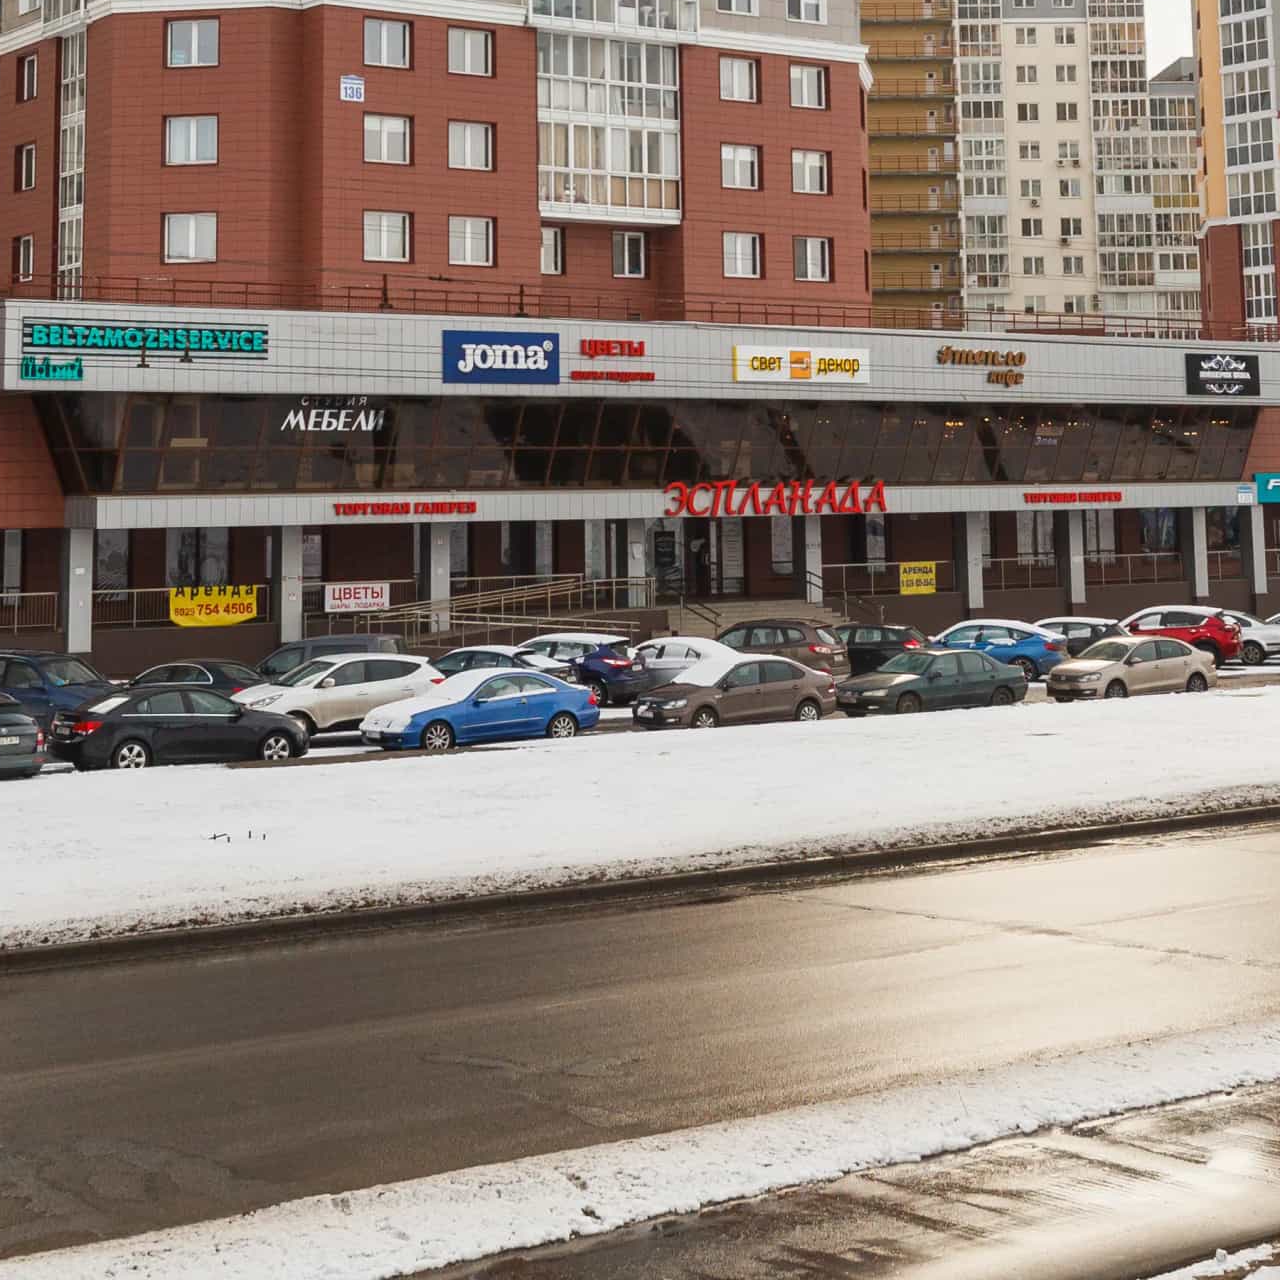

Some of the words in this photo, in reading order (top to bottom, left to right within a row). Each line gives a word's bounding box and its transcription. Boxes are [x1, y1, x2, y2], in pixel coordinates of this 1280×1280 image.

[344, 86, 362, 100] 136
[31, 324, 265, 352] BELTAMOZHSERVICE
[580, 338, 645, 358] ЦВЕТЫ
[750, 355, 782, 371] свет
[816, 356, 860, 376] декор
[280, 408, 385, 432] МЕБЕЛИ
[663, 479, 888, 518] ЭСПЛАНАДА
[175, 583, 254, 601] Аренда
[332, 586, 384, 602] ЦВЕТЫ
[197, 603, 221, 616] 754
[223, 602, 254, 616] 4506
